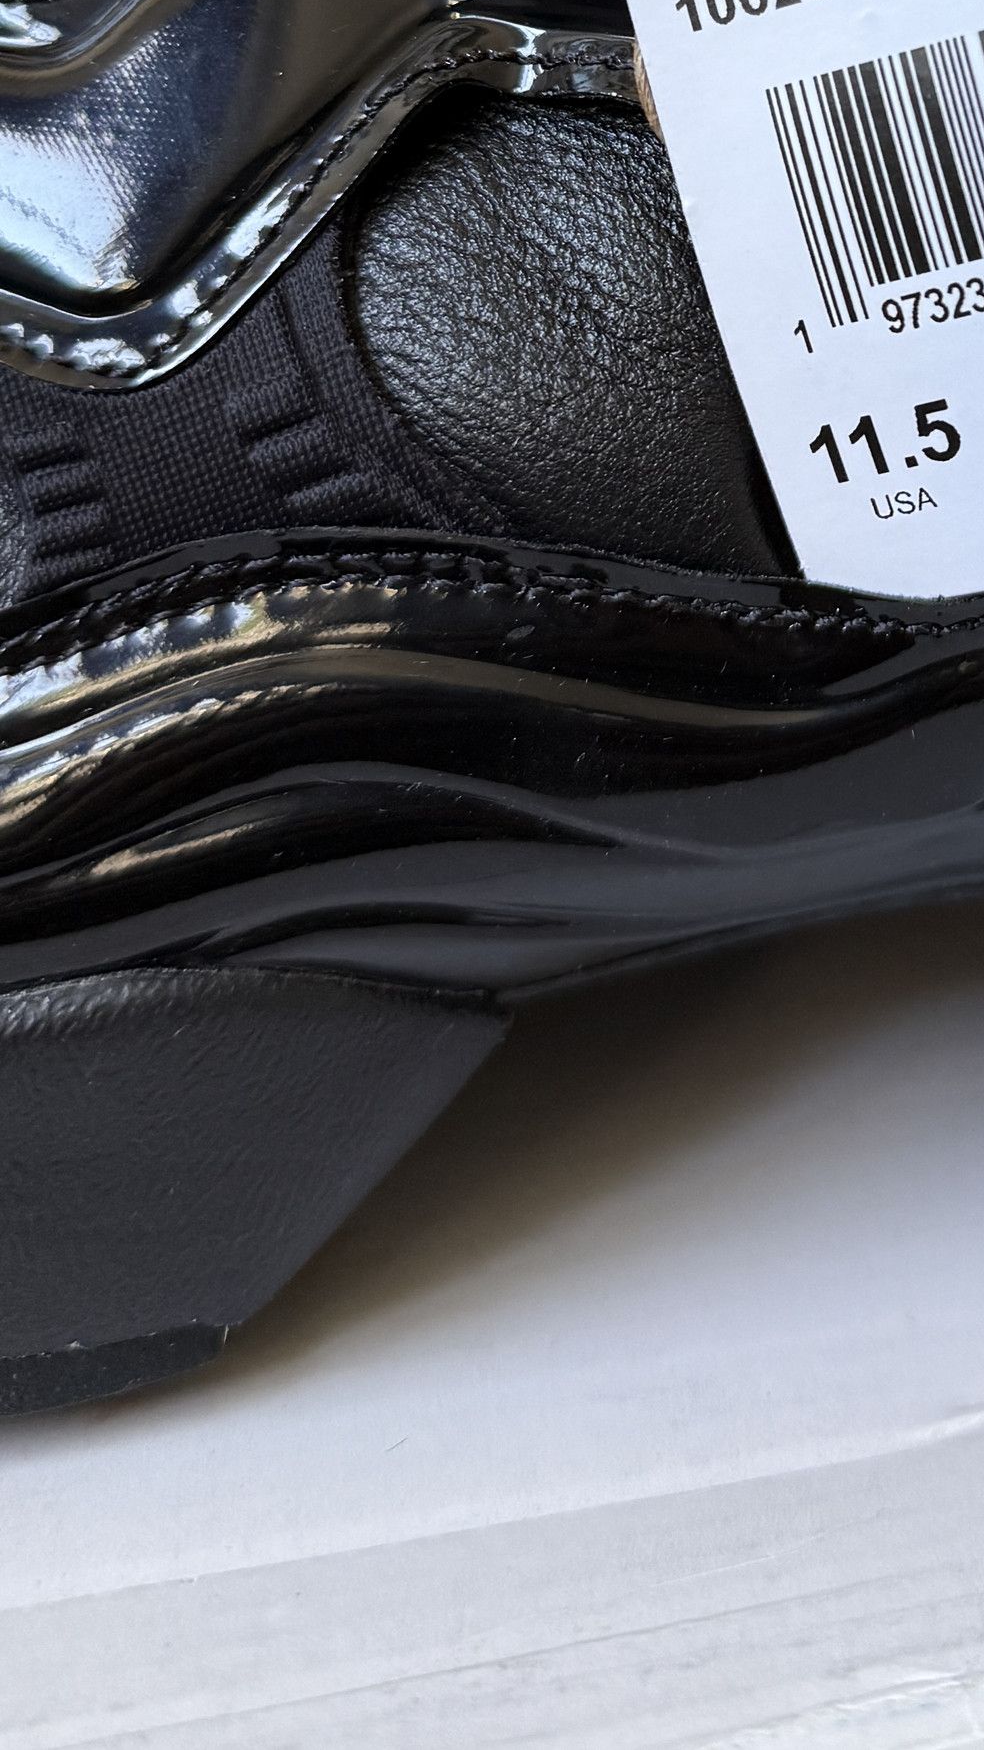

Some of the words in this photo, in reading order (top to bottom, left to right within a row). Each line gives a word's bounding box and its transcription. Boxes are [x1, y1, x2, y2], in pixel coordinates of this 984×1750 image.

[793, 319, 814, 354] 1
[809, 398, 962, 484] 11.5
[870, 487, 938, 520] USA
